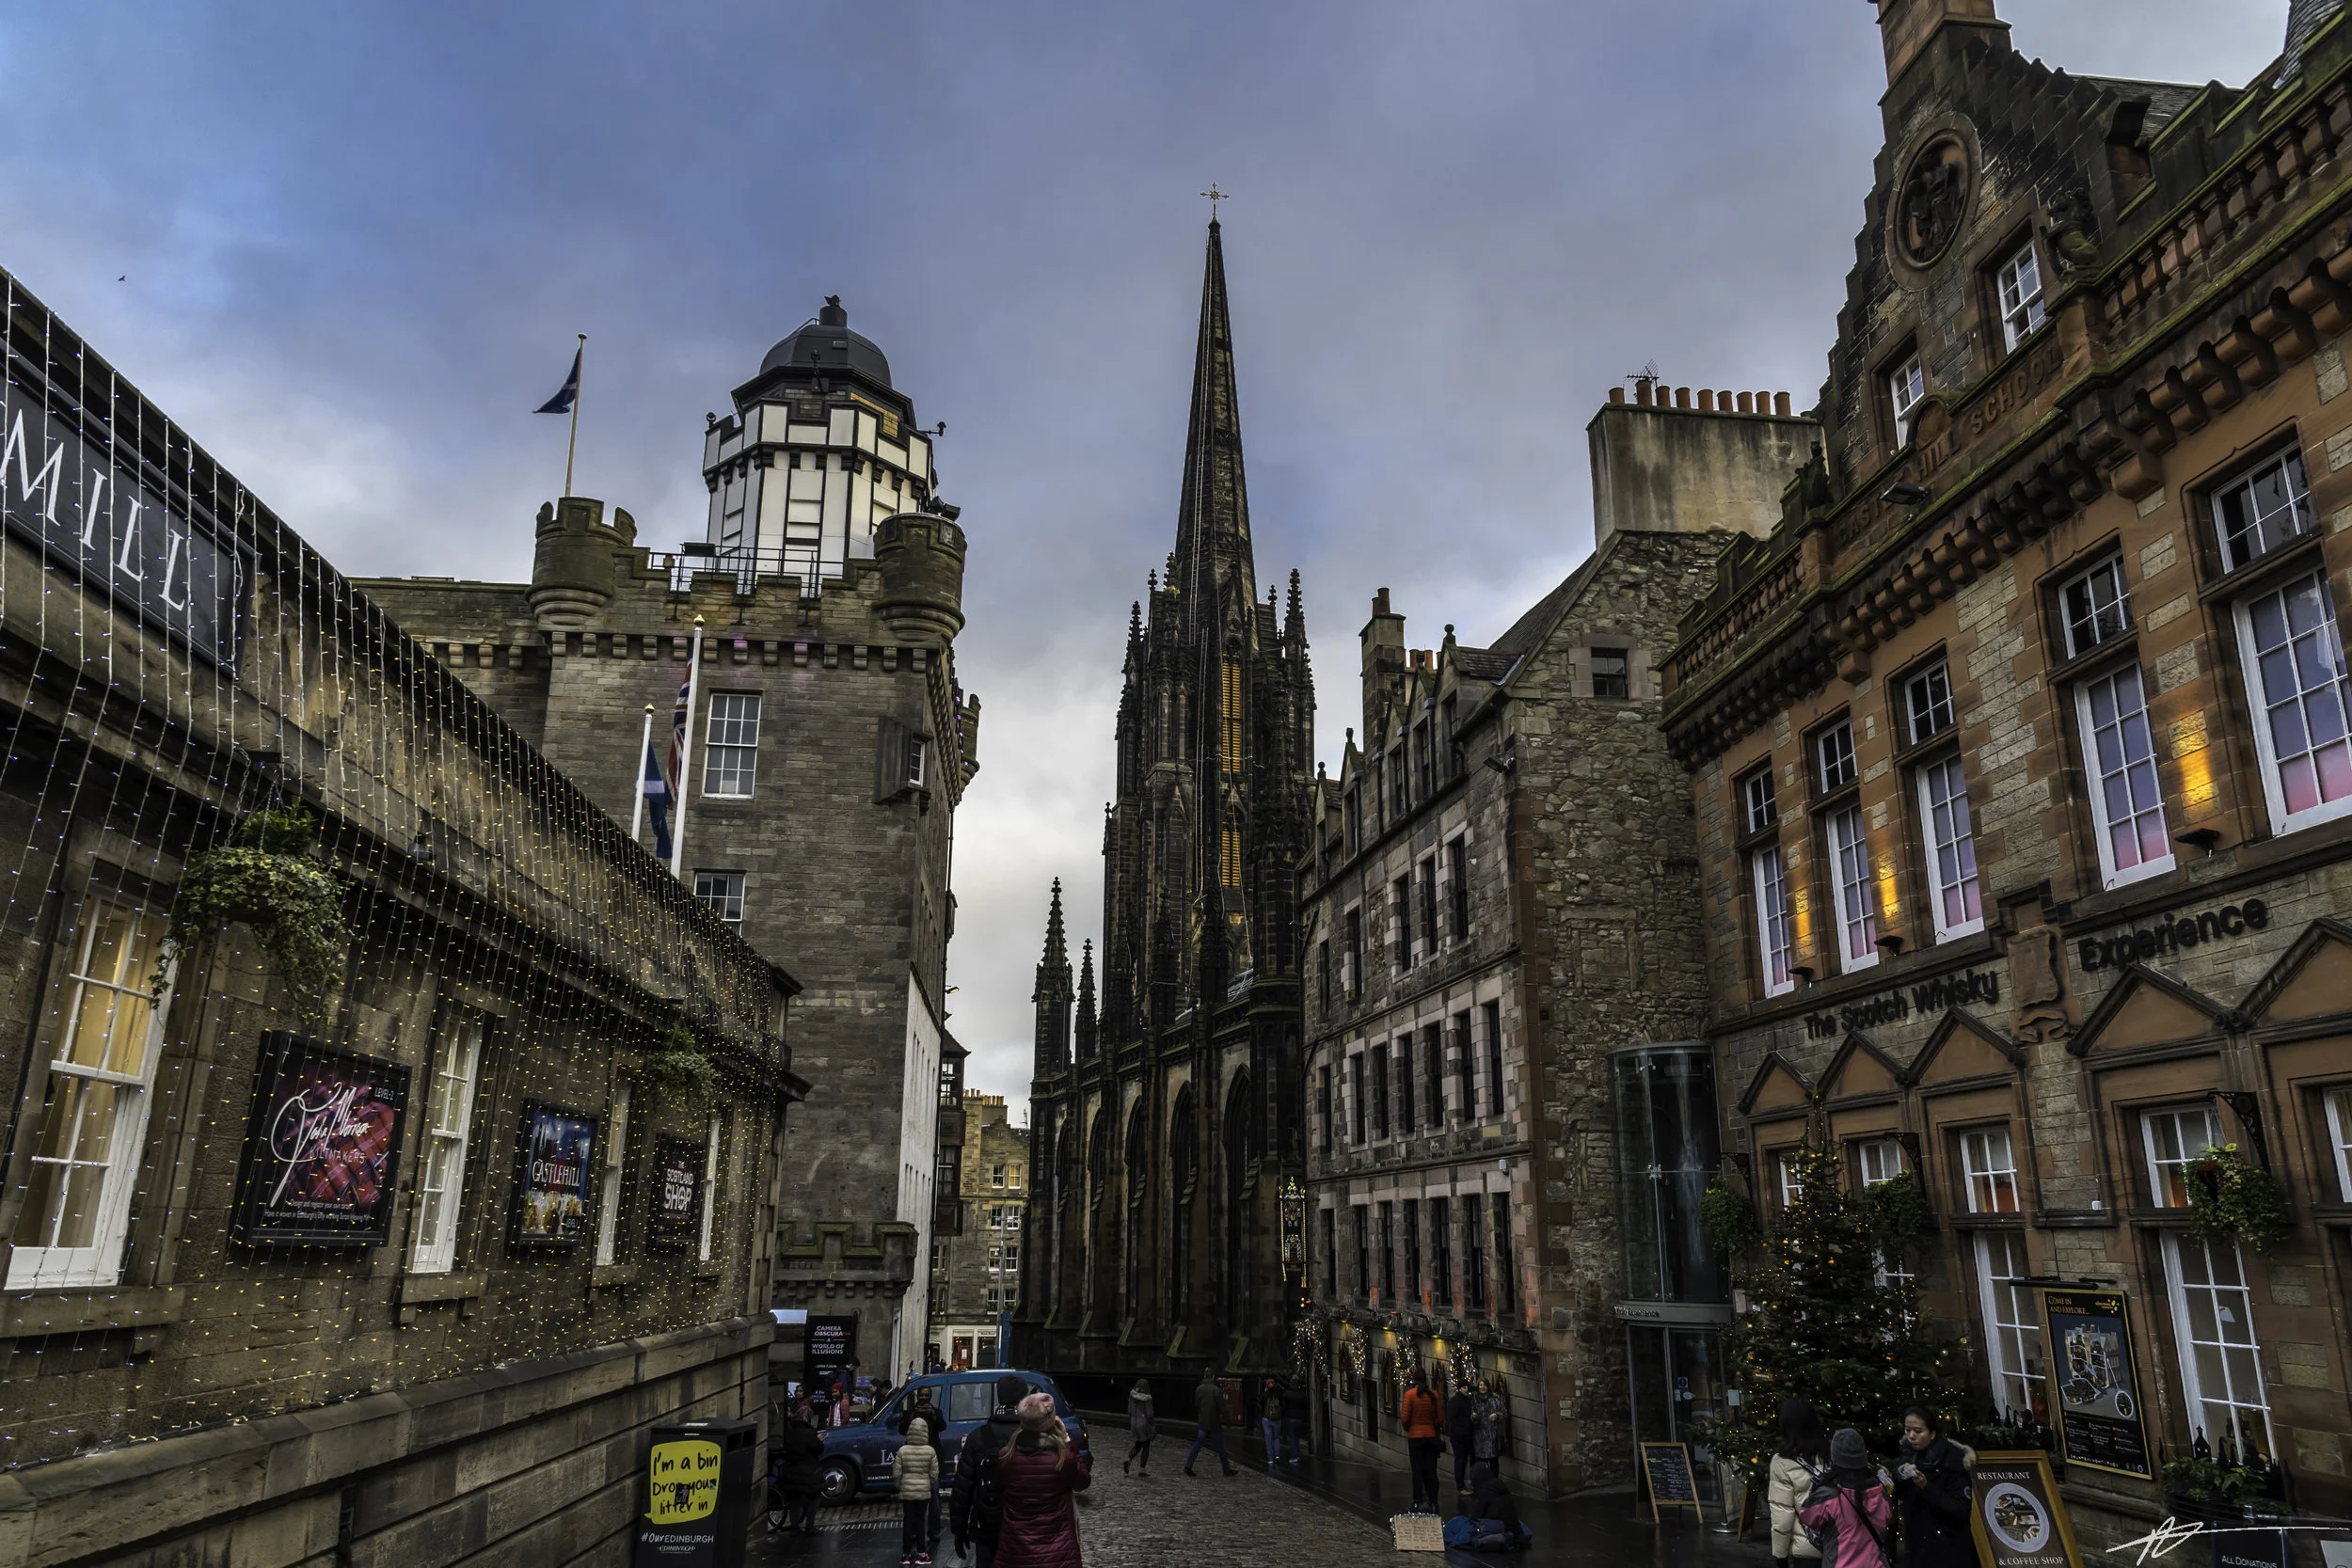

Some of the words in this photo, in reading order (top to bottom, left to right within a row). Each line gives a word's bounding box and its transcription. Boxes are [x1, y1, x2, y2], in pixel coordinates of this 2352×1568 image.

[1917, 432, 1963, 482] HILL
[1970, 346, 2062, 435] SCHOOL
[0, 408, 185, 611] MILL
[1804, 1012, 1836, 1040] The
[1840, 990, 1908, 1032] Scotch
[1912, 969, 1999, 1014] Whisky
[2077, 898, 2268, 972] Experience
[532, 1161, 580, 1187] CASTLEHILL
[666, 1168, 694, 1185] SCOTLAND
[663, 1183, 693, 1211] SHOP
[653, 1451, 674, 1476] I'm
[680, 1456, 691, 1470] a
[697, 1449, 718, 1470] bin
[1977, 1471, 2030, 1481] RESTAURANT
[653, 1481, 675, 1497] Dro
[689, 1479, 709, 1496] you
[698, 1496, 708, 1512] in
[641, 1532, 714, 1544] #OurEDINBURGH
[2007, 1557, 2040, 1565] COFFEE
[2041, 1556, 2064, 1564] SHOP
[2221, 1555, 2235, 1565] ALL
[2235, 1557, 2278, 1568] DONATIONS
